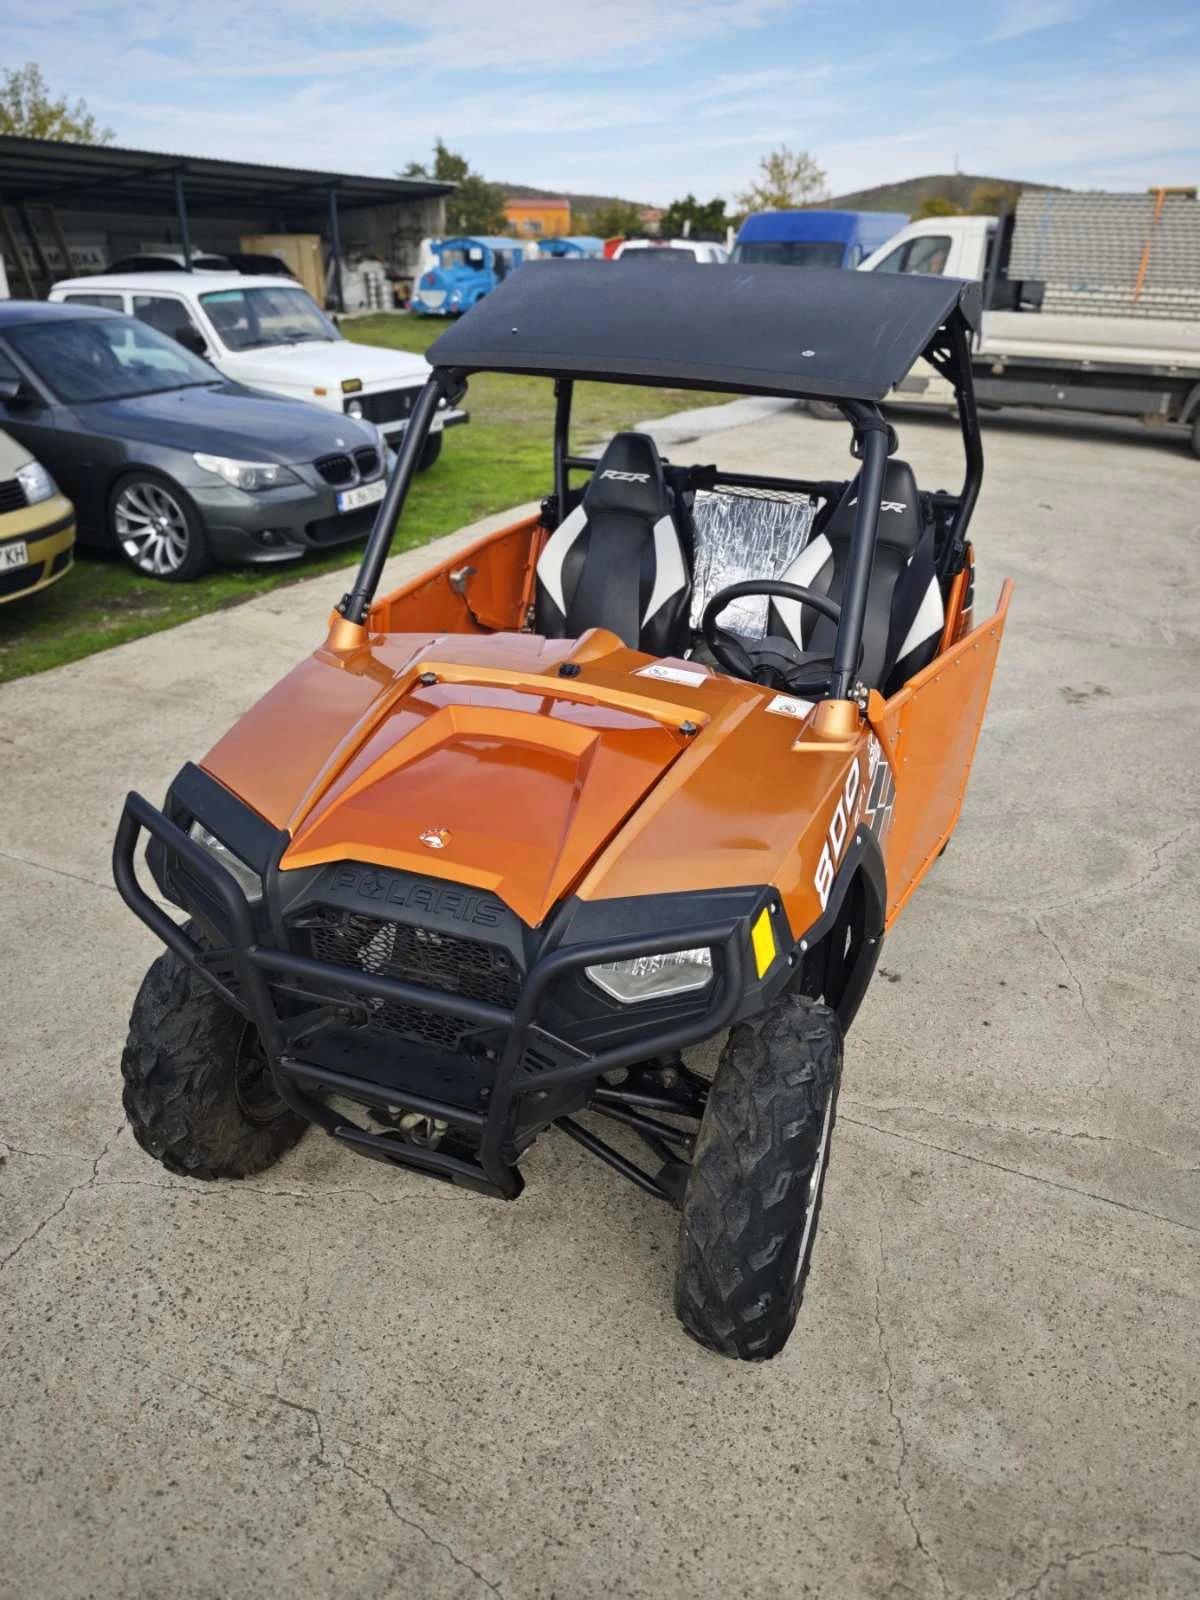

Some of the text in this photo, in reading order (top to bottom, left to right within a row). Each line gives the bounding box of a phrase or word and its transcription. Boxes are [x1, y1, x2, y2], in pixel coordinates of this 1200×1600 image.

[600, 469, 650, 483] RZR
[814, 757, 860, 912] 800
[331, 868, 505, 928] POLARIS
